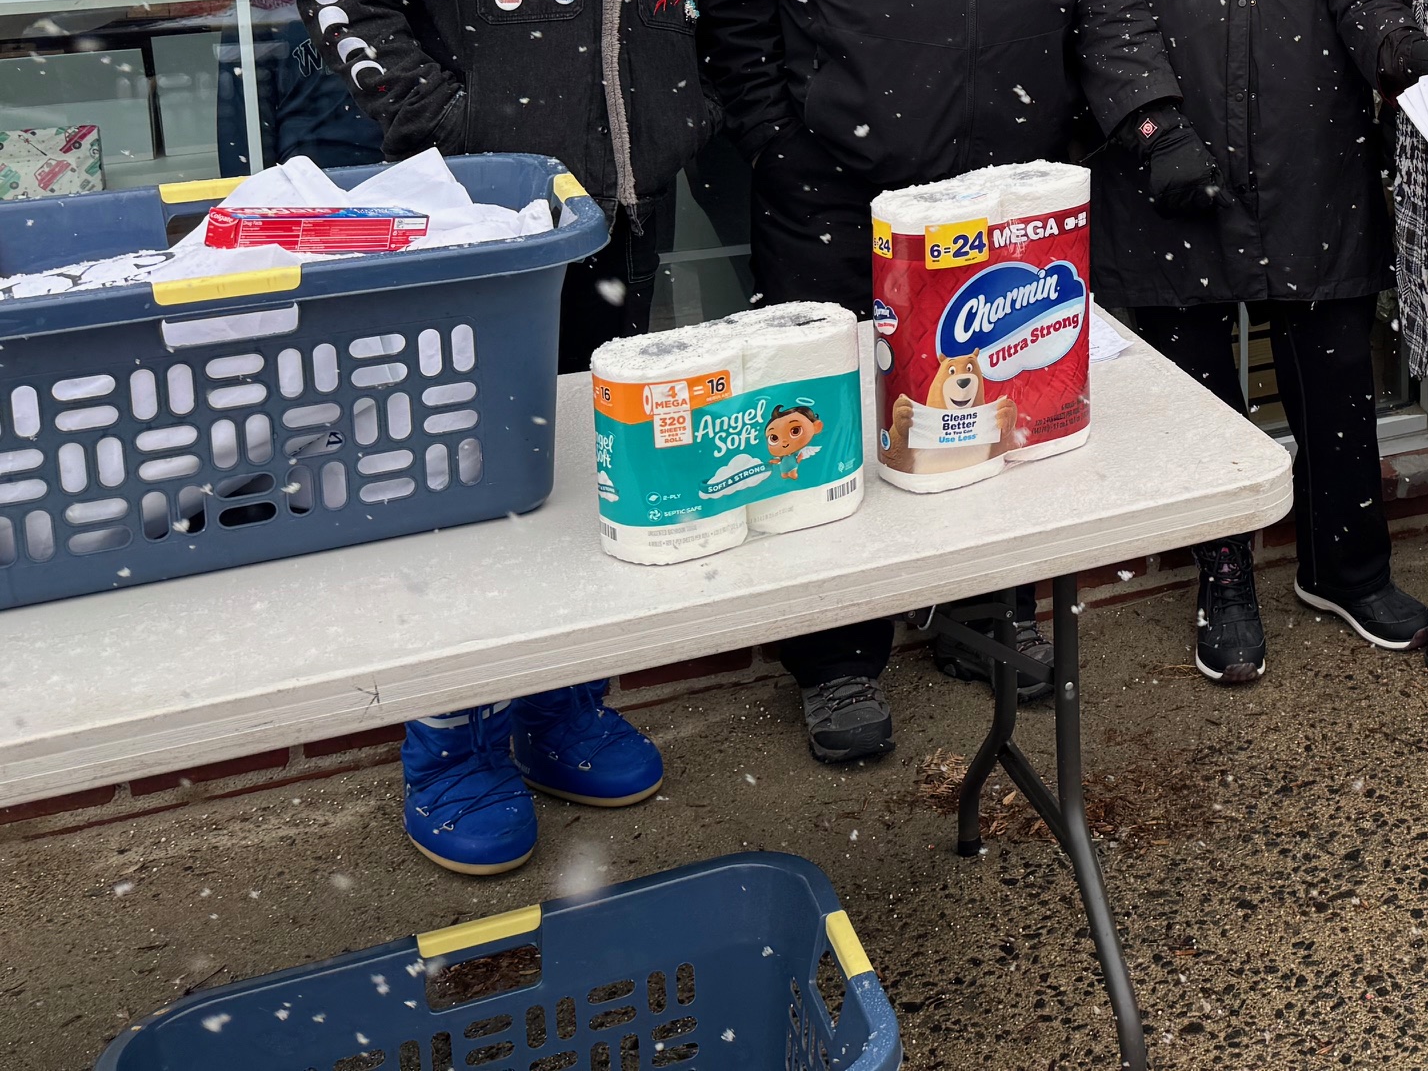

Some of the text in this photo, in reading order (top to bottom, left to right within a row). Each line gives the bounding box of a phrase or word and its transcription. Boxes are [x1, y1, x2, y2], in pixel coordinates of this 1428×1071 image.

[210, 211, 234, 224] Colgate
[992, 218, 1059, 249] MEGA
[954, 269, 1059, 343] Charmin
[988, 313, 1080, 368] Ultra Strong
[666, 385, 678, 399] 4
[707, 376, 726, 395] 16
[655, 398, 688, 409] MEGA
[659, 415, 686, 427] 320
[694, 399, 766, 443] Angel
[941, 412, 978, 422] Cleans
[660, 426, 687, 434] SHEETS
[942, 421, 977, 431] Better
[664, 436, 683, 444] ROLL
[713, 425, 760, 458] Soft
[958, 434, 977, 442] Less
[707, 481, 727, 493] SOFT
[734, 465, 766, 482] STRONG
[662, 493, 682, 501] 2-PLY
[664, 505, 703, 517] SEPTIC SAFE
